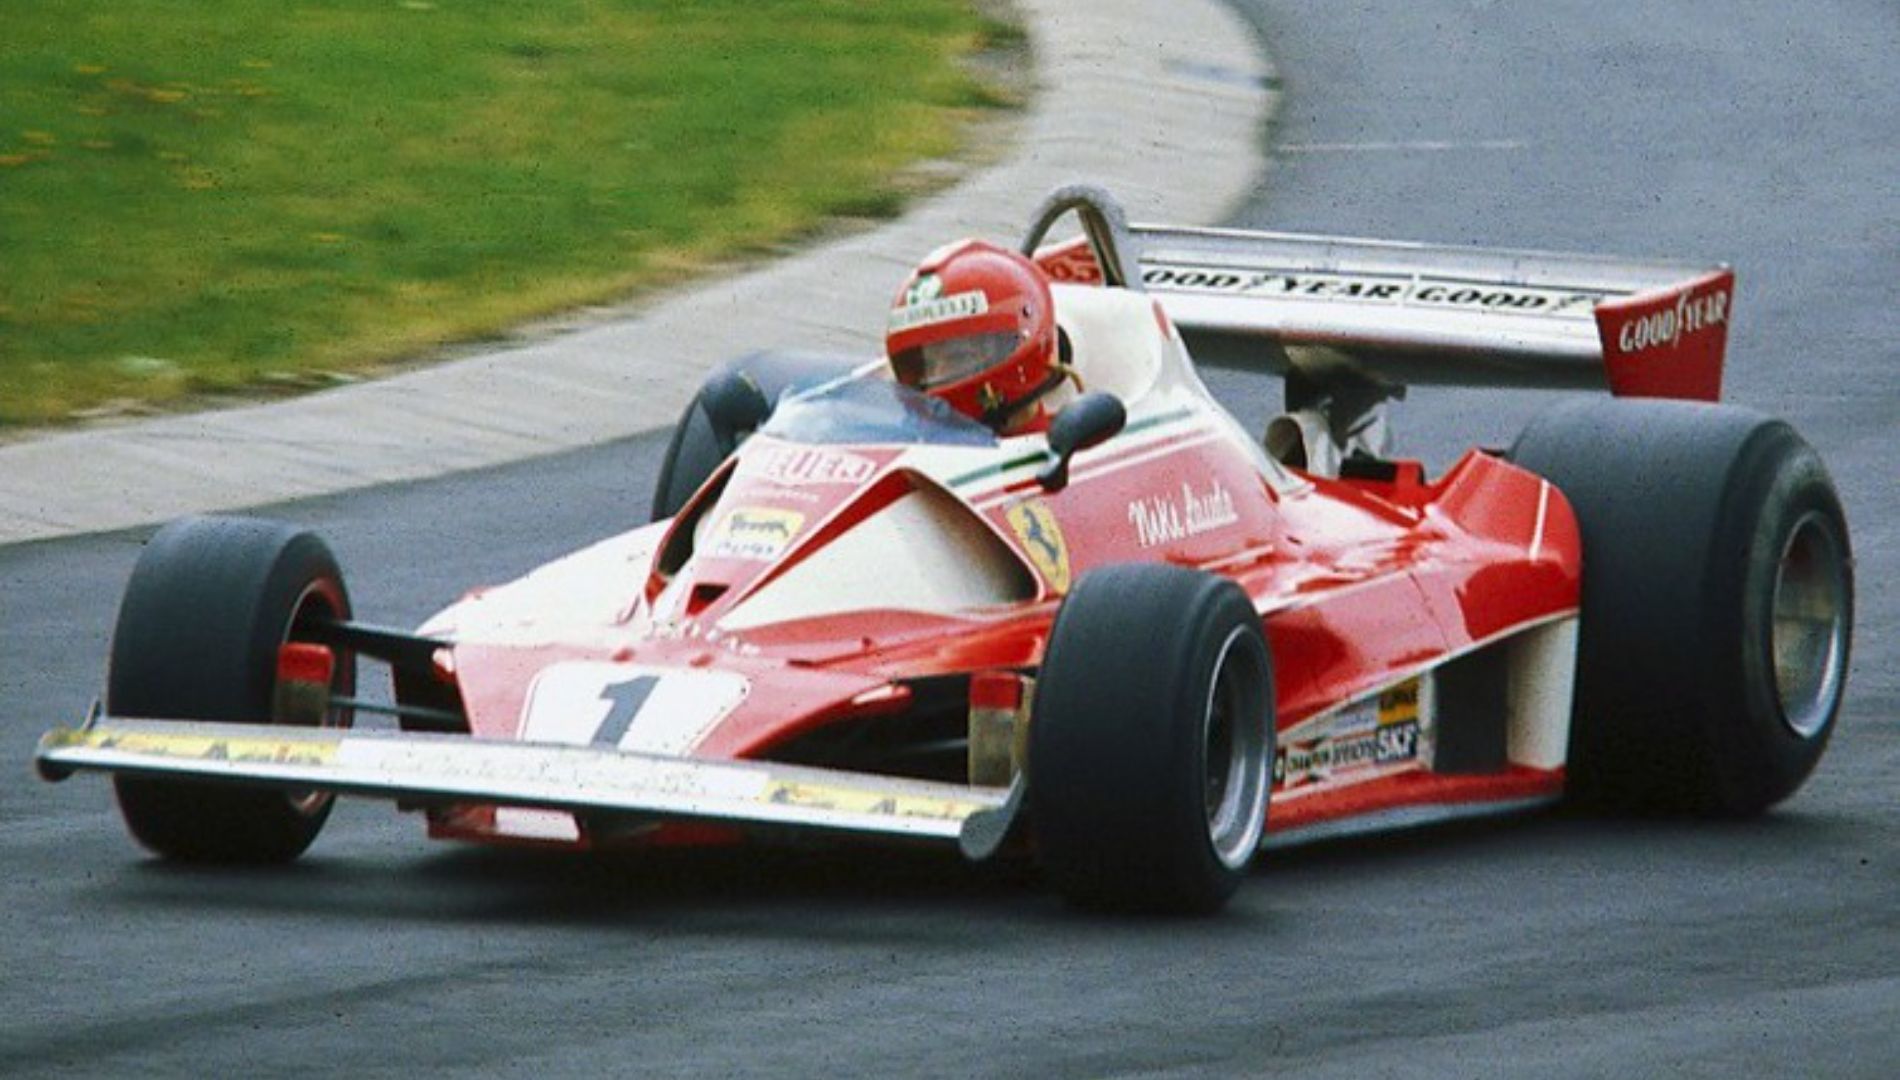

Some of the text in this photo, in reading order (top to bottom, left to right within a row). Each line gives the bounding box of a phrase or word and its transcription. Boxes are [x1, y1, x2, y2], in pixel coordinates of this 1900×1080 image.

[1142, 269, 1548, 308] OOD YEAR GOOD
[589, 674, 661, 749] 1
[1378, 723, 1419, 761] SKF
